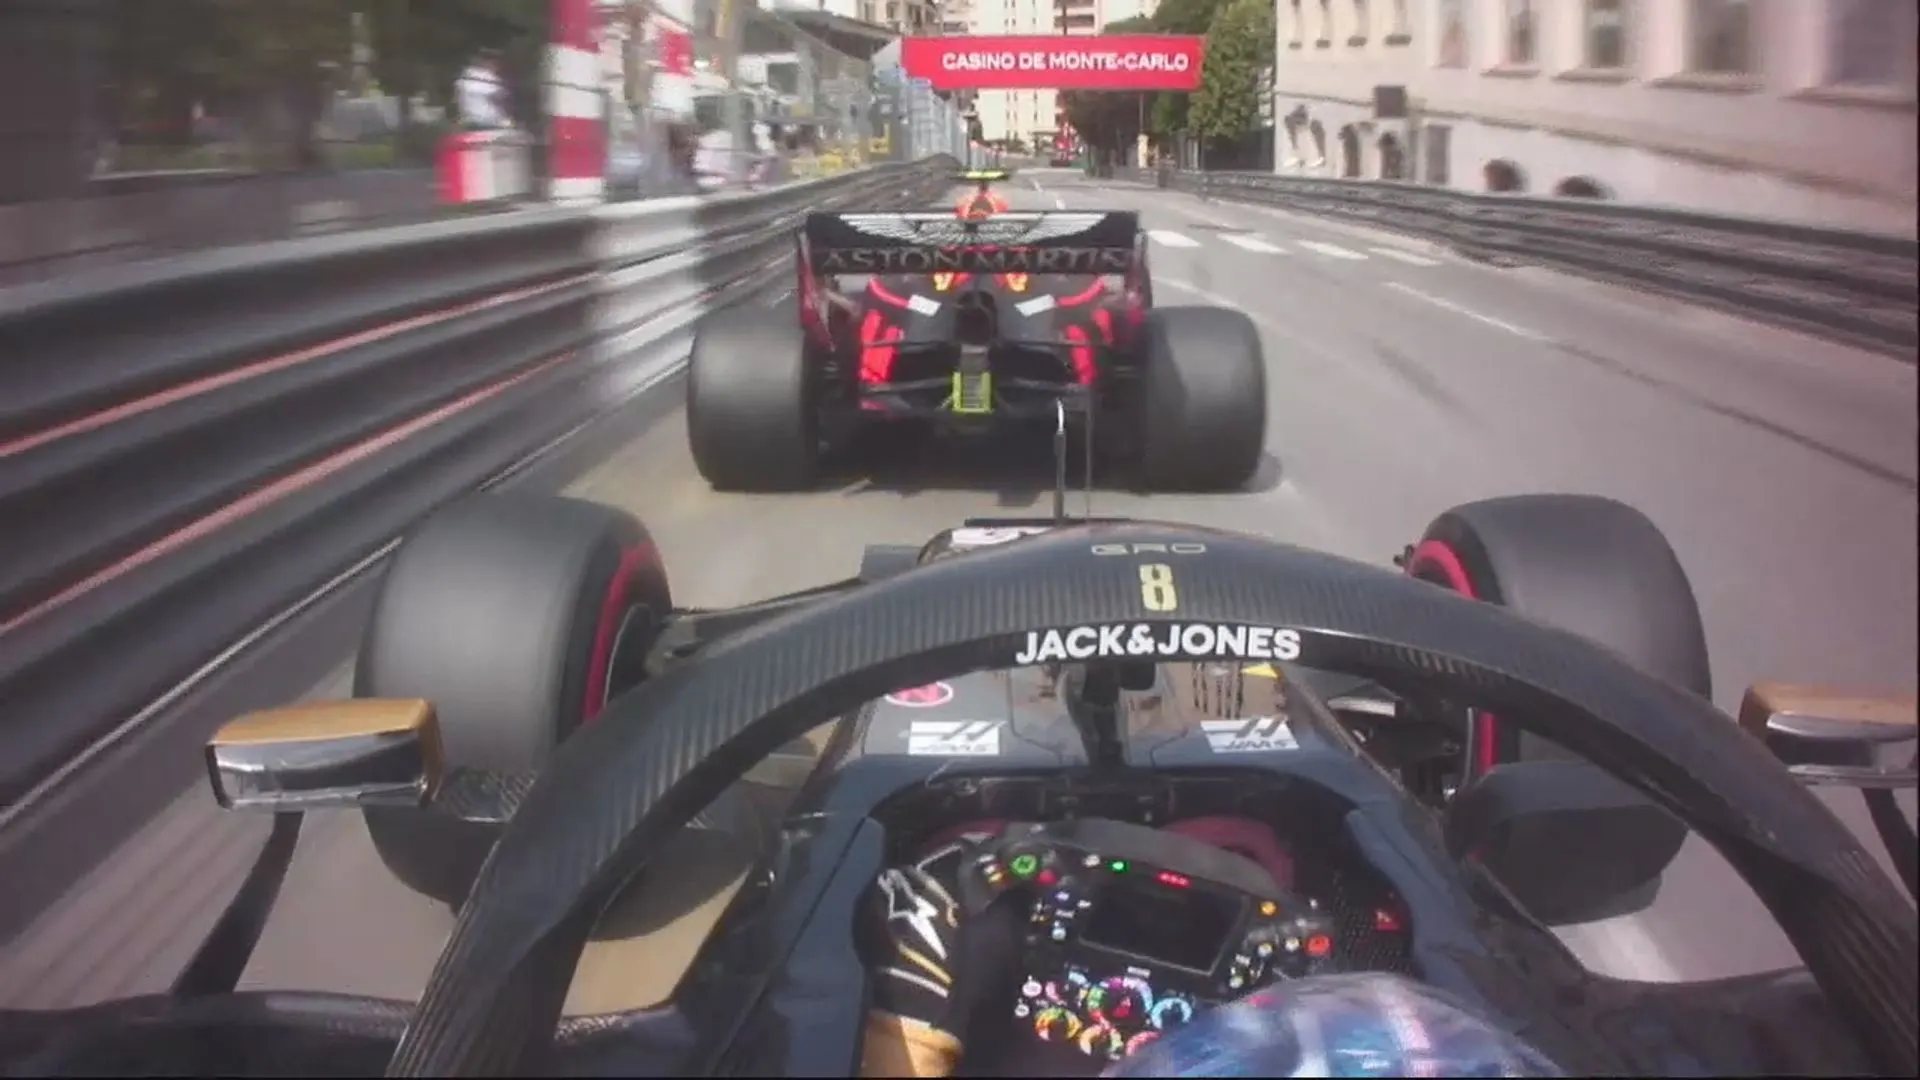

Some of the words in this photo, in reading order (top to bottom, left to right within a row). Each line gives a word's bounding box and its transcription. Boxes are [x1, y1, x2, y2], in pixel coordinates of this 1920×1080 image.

[942, 52, 1014, 71] CASINO
[1019, 52, 1046, 70] DE
[1050, 52, 1189, 72] MONTE-CARLO
[823, 247, 964, 269] ASTON
[1139, 563, 1178, 612] 8
[1016, 624, 1301, 664] JACK&JONES
